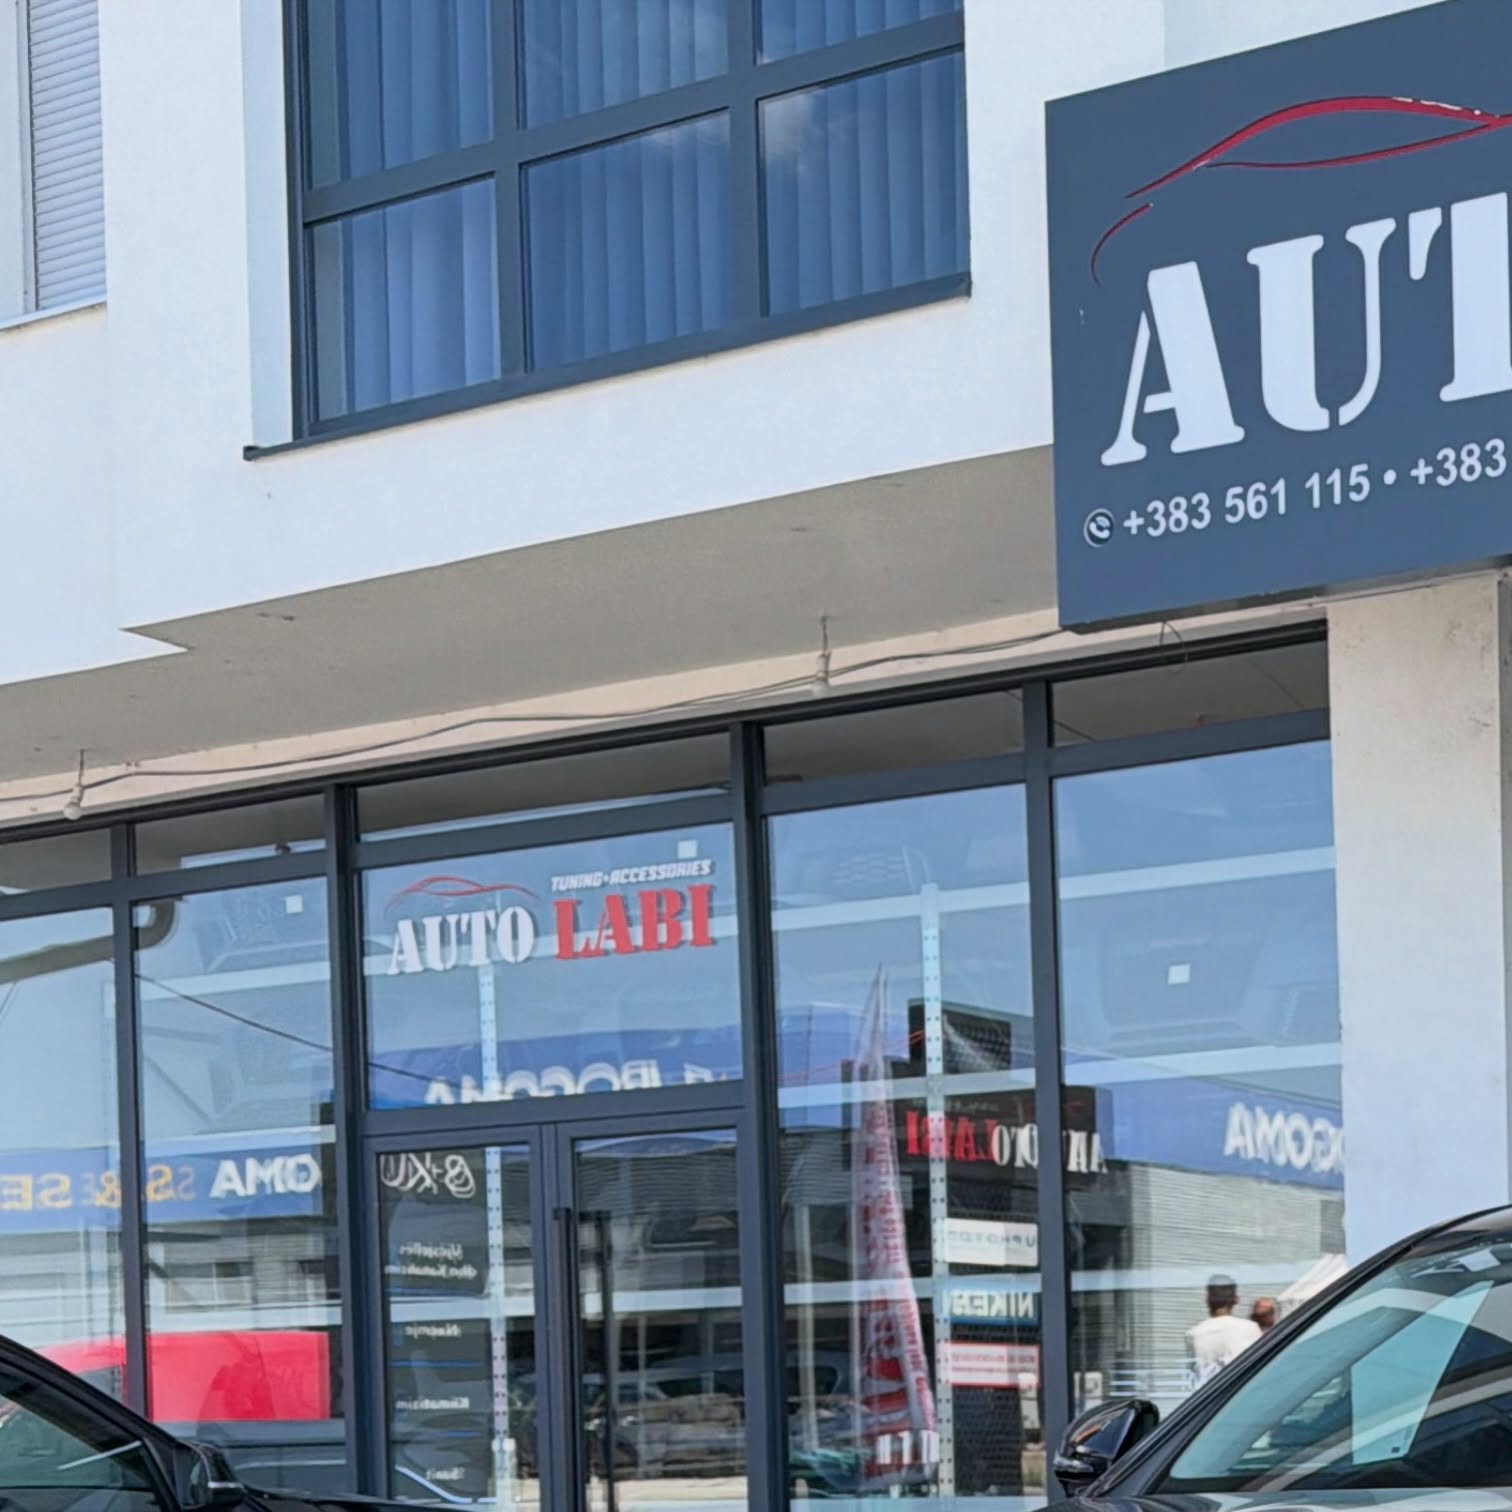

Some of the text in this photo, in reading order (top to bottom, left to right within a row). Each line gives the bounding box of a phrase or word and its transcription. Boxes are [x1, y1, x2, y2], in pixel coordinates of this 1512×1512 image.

[1122, 490, 1212, 540] +383
[1224, 476, 1289, 527] 561
[1304, 463, 1372, 511] 115
[1408, 437, 1508, 488] +383
[551, 859, 712, 892] TUNING ACCESSORIES
[387, 883, 714, 974] AUTO LABI
